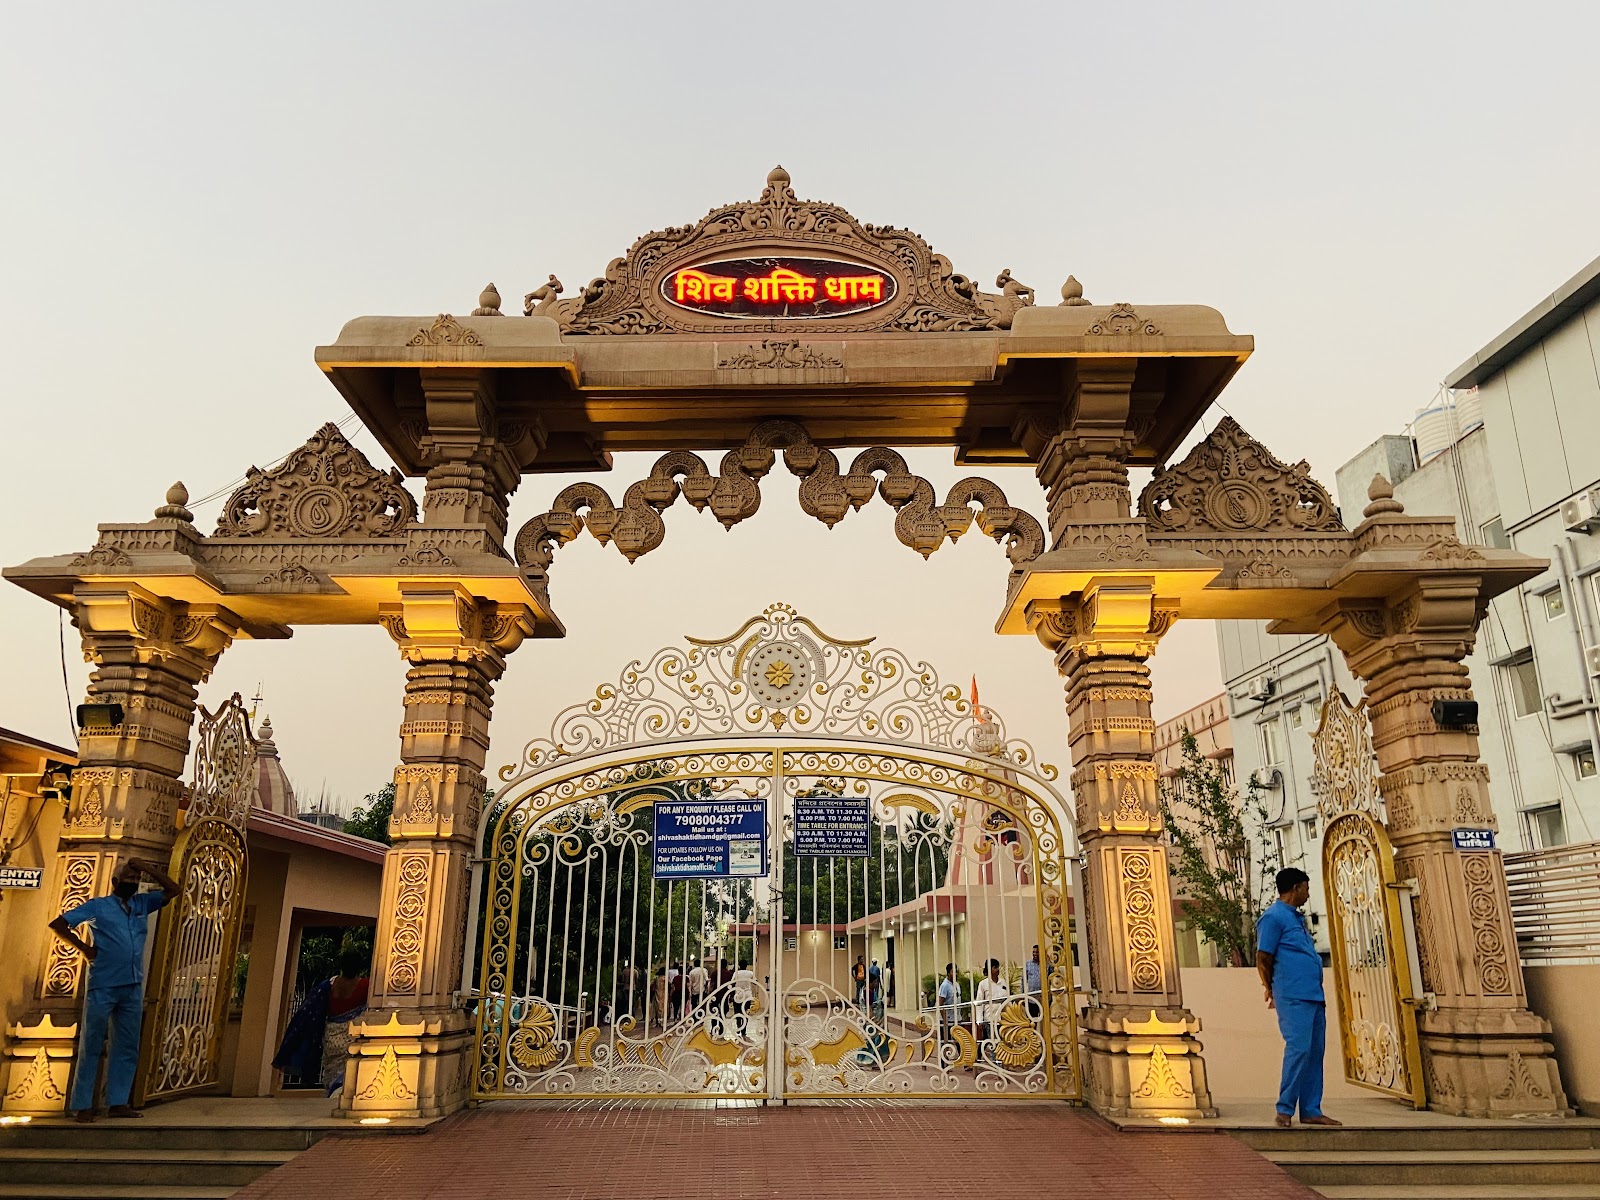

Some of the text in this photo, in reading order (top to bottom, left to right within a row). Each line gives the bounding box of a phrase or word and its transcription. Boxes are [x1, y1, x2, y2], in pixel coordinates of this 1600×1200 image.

[675, 268, 884, 303] शिव शक्ति धाम
[659, 804, 762, 814] FOR ANY ENQUIRY PLEASE CALL ON
[675, 814, 744, 826] 7908004377
[1456, 831, 1489, 839] EXIT
[668, 846, 687, 854] UPDATES
[688, 846, 707, 854] FOLLOW
[706, 855, 723, 863] Page
[0, 869, 40, 878] ENTRY
